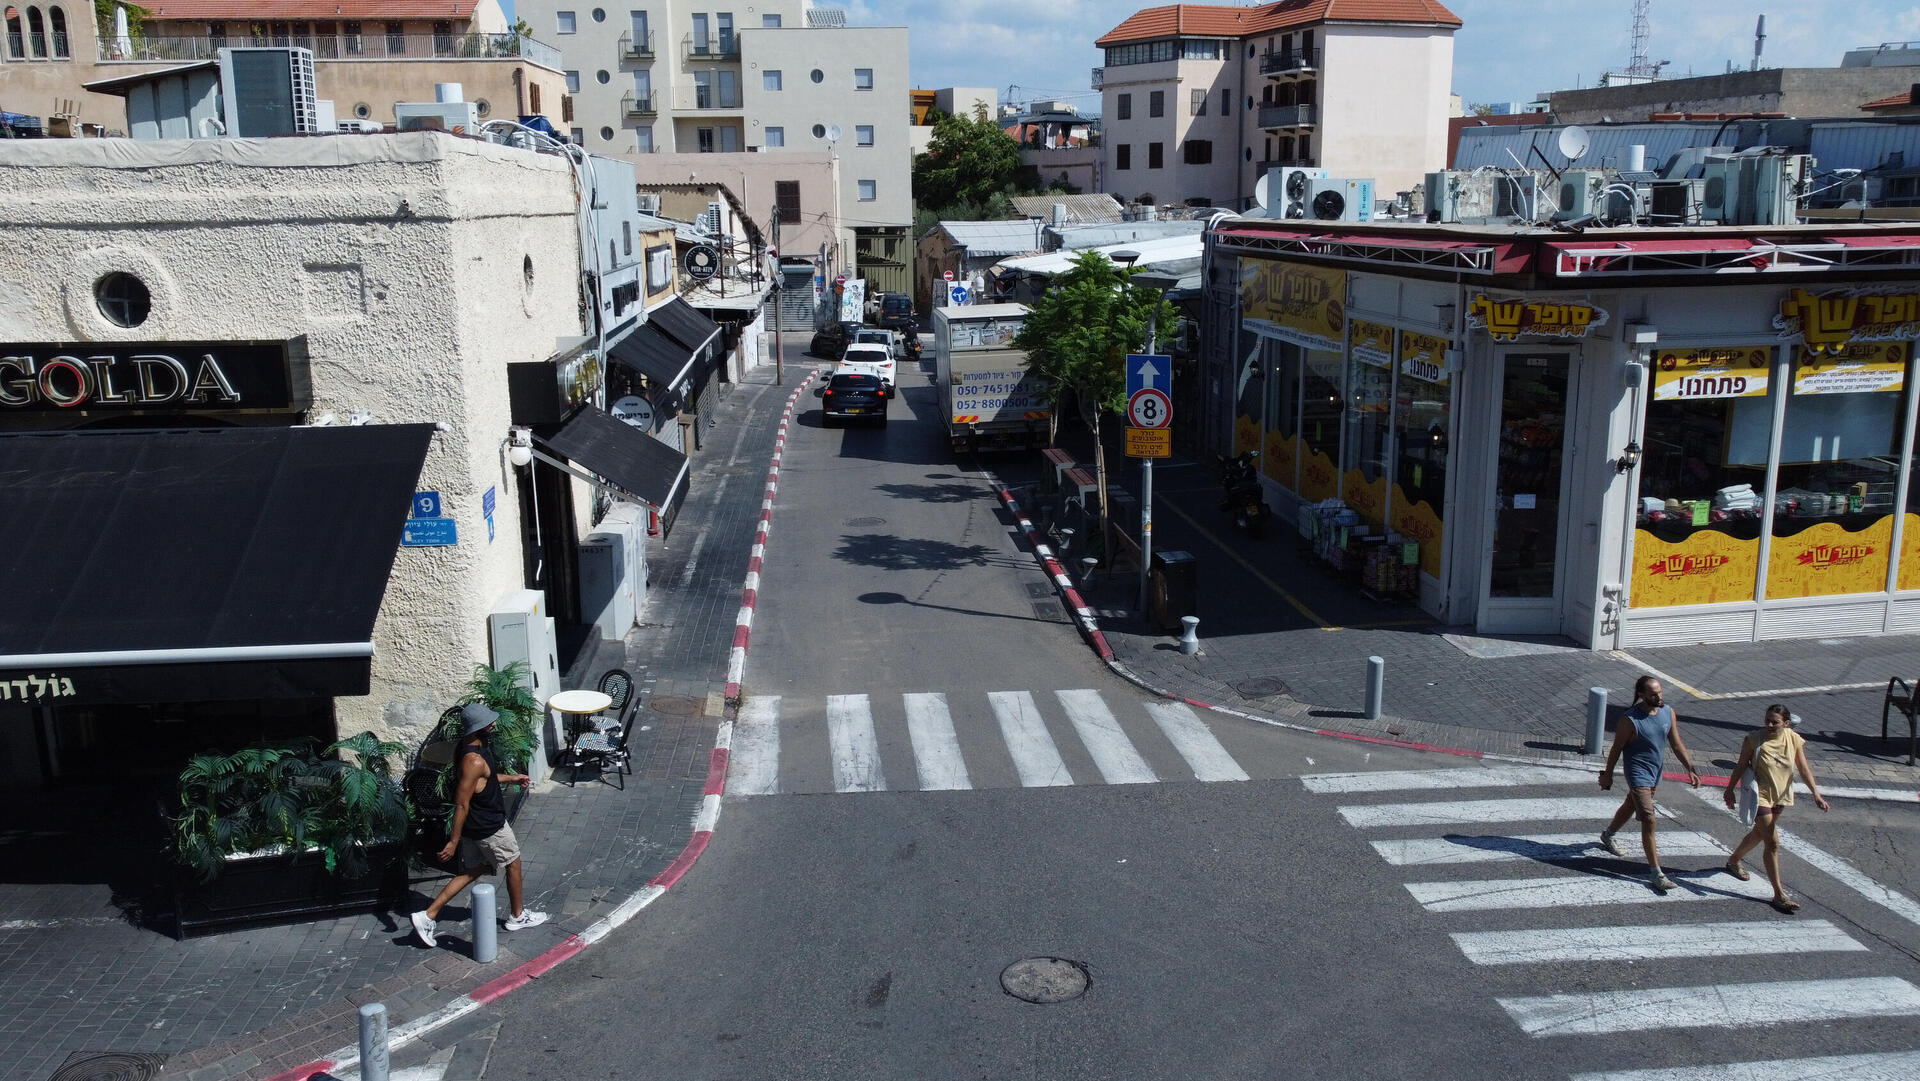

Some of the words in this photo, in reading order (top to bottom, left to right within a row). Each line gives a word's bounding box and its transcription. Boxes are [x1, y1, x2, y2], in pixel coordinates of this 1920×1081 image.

[1470, 295, 1521, 335] שלי
[1526, 304, 1592, 325] סופר
[1782, 288, 1859, 343] שלי
[1864, 295, 1917, 322] ופר
[1530, 324, 1561, 334] SUPER
[1564, 325, 1585, 335] FUN
[1859, 323, 1898, 338] SUPER
[1901, 322, 1920, 337] FU
[963, 371, 991, 380] למסעדות
[1409, 357, 1439, 381] פתחנו!
[0, 354, 241, 407] GOLDA
[957, 383, 1030, 396] 050-7451981
[1677, 376, 1747, 397] פתחנו!
[957, 398, 1029, 410] 052-8800500
[1144, 399, 1156, 419] 8
[420, 497, 434, 513] 9
[1688, 556, 1722, 568] סופר
[1835, 547, 1867, 559] סופר
